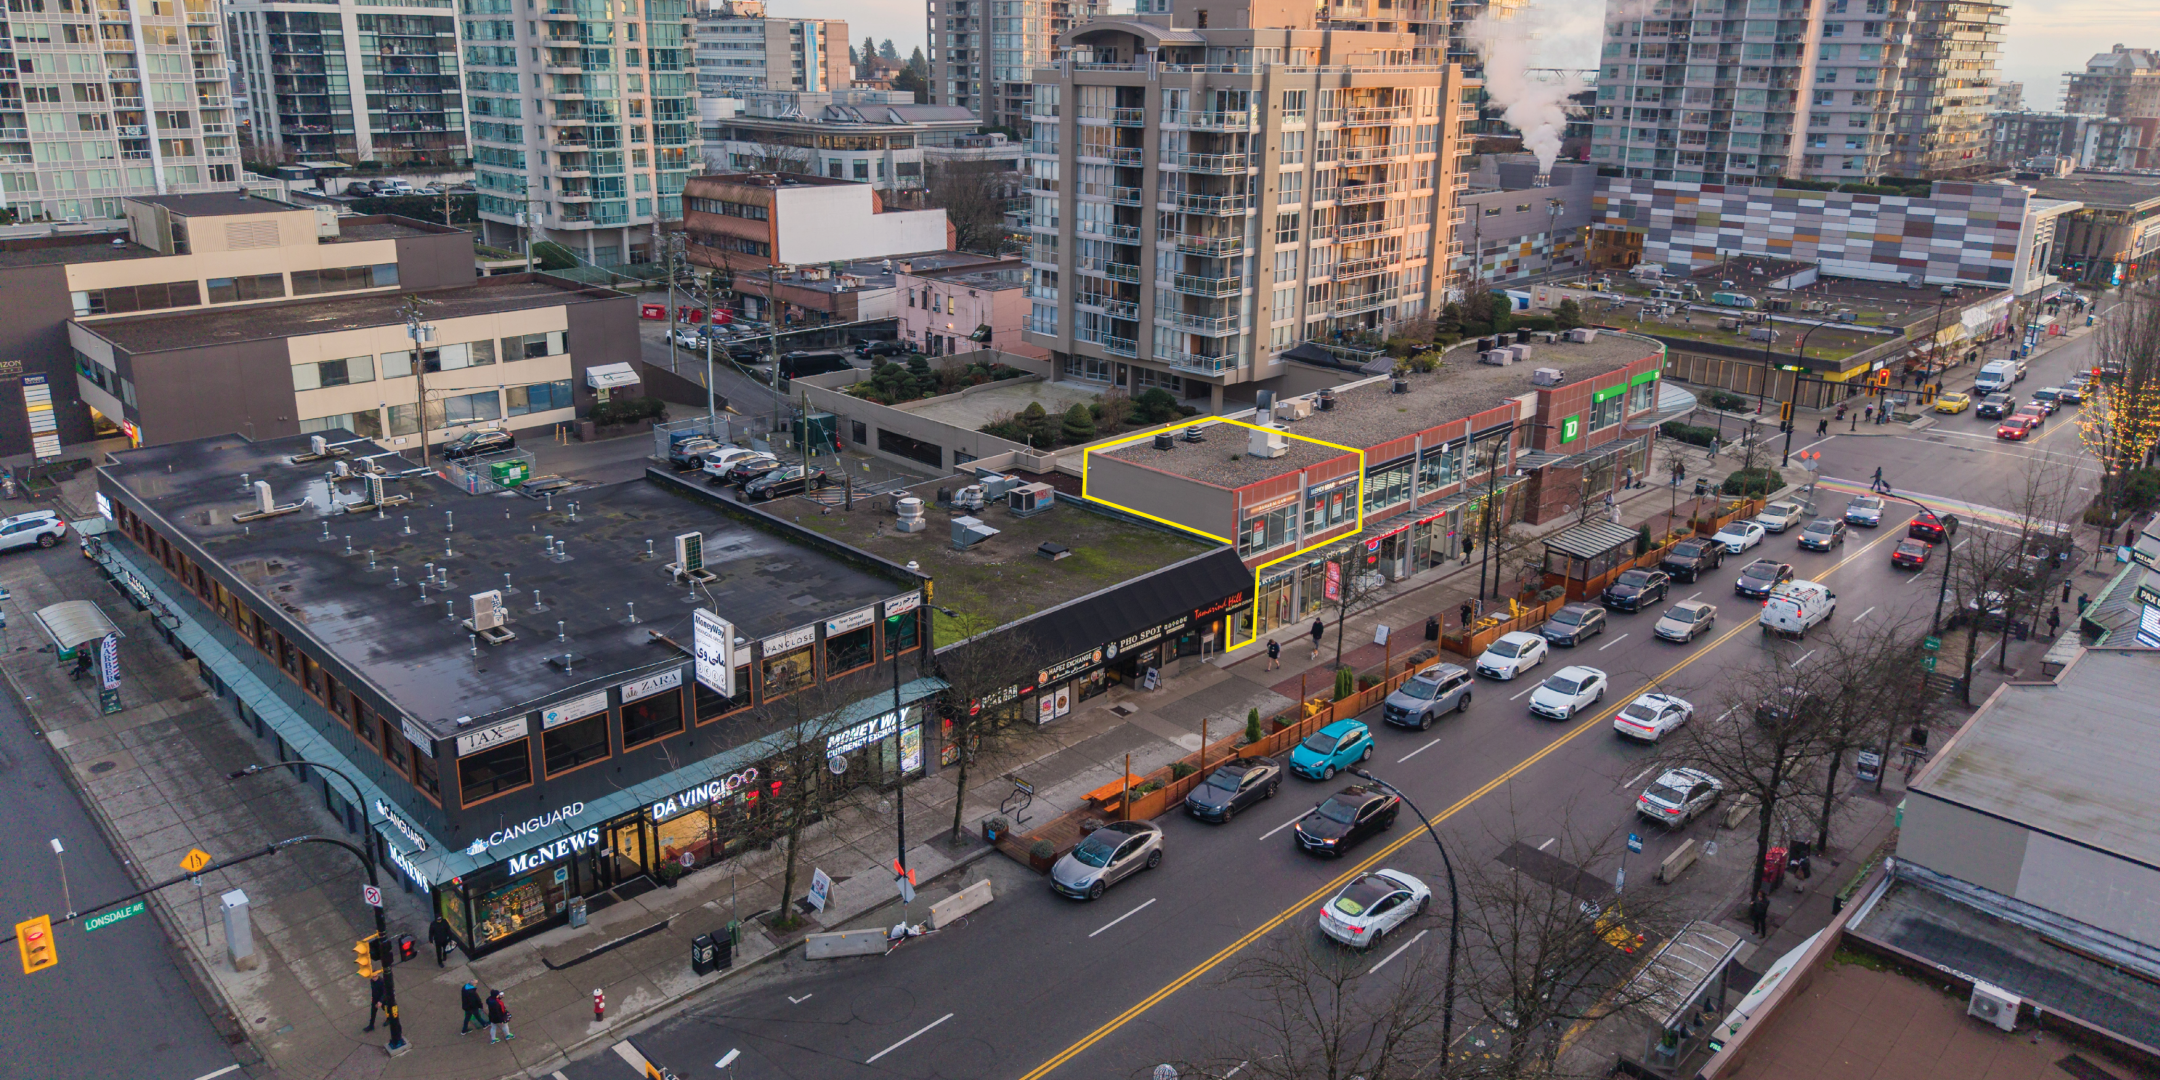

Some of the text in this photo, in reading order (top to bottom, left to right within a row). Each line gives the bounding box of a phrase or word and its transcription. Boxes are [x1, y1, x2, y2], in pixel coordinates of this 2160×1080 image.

[1566, 420, 1578, 438] TD
[2134, 552, 2144, 561] PAX
[1228, 591, 1242, 607] Hill
[2141, 590, 2157, 604] PAX
[695, 615, 725, 638] MoneyWay
[1120, 635, 1137, 648] PHO
[1140, 624, 1162, 640] SPOT
[765, 632, 814, 654] VANCLOSE
[103, 641, 114, 683] BARBER
[642, 674, 677, 691] ZARA
[464, 726, 503, 747] TAX
[827, 718, 879, 748] MONEY
[652, 797, 677, 820] DA
[679, 778, 726, 809] VINCI
[383, 805, 427, 852] CANGUARD
[489, 801, 585, 846] CANGUARD
[508, 826, 600, 876] McNEWS
[387, 842, 430, 894] McNEWS
[85, 902, 144, 931] LONSDALE AVE
